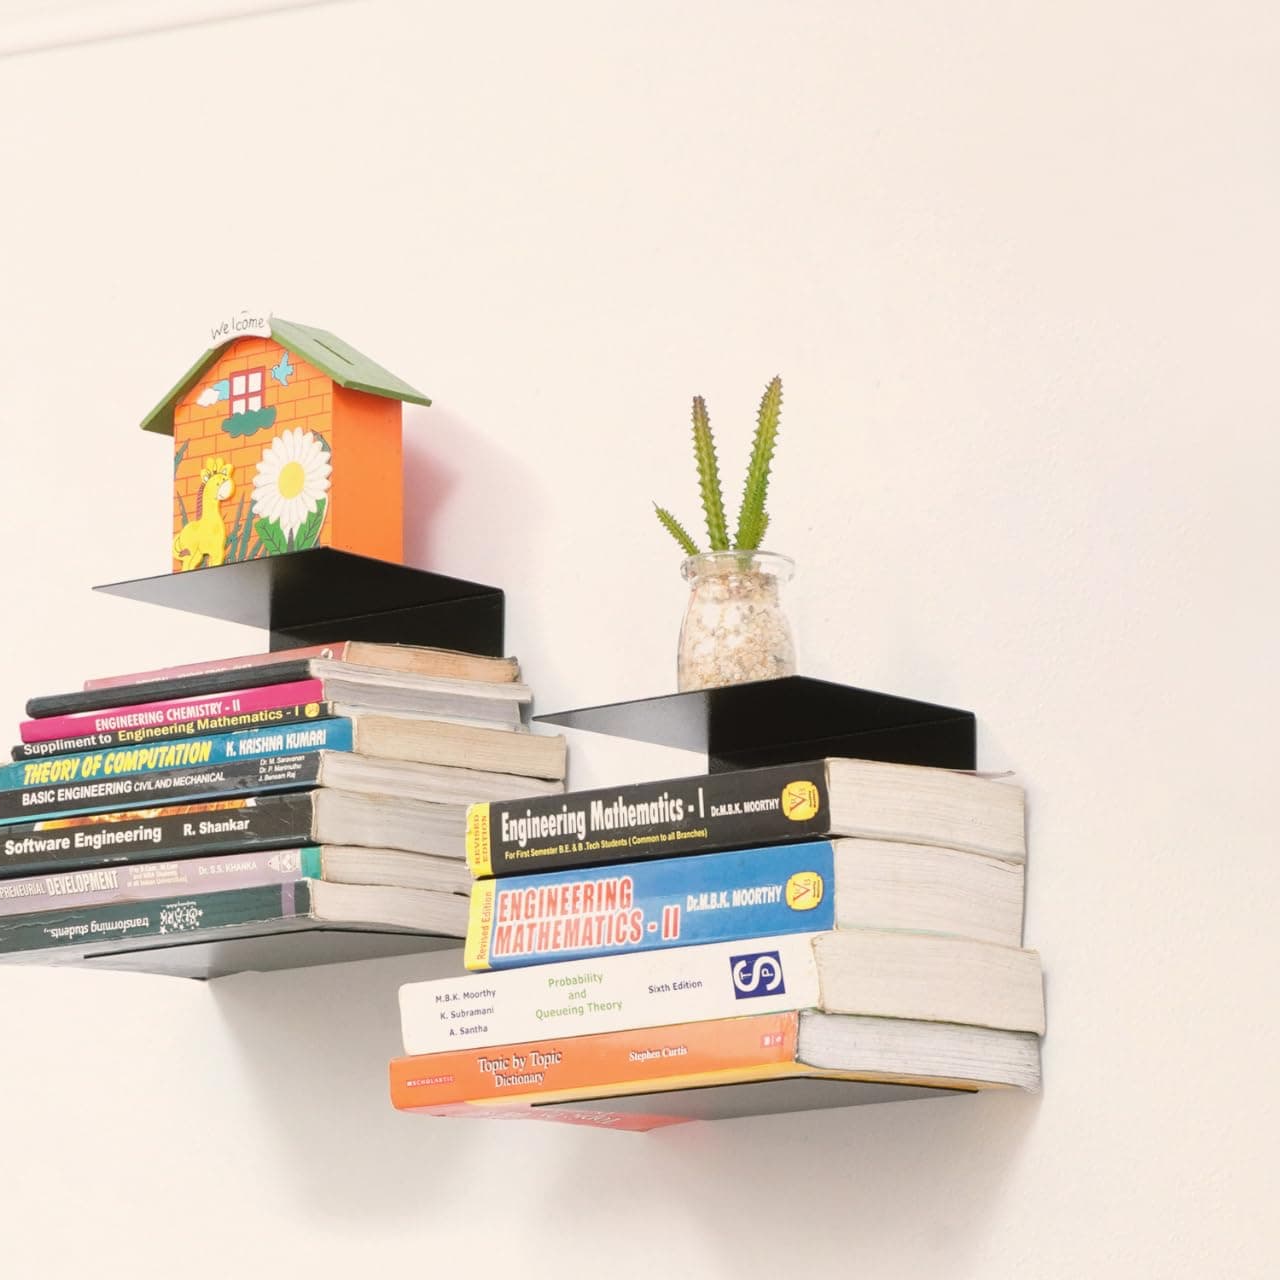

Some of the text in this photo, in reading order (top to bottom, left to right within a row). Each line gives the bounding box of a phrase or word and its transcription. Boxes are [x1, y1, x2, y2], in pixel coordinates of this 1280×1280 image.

[210, 315, 265, 340] Welcome
[95, 710, 164, 731] ENGINEERING
[166, 701, 223, 721] CHEMISTRY
[23, 734, 97, 756] Suppliment
[98, 733, 112, 745] to
[117, 721, 194, 742] Engineering
[197, 709, 283, 731] Mathematics
[225, 729, 327, 757] K. KRISHNA KUMARI
[23, 740, 213, 785] THEORY OF COMPUTATION
[22, 771, 226, 806] BASIC ENGINEERING CIVIL AND MECHANICAL
[743, 798, 780, 813] MOORTHY
[183, 817, 250, 836] R. Shankar
[501, 804, 586, 847] Engineering
[590, 792, 684, 831] Mathematics
[4, 826, 162, 855] Software Engineering
[504, 851, 516, 860] For
[516, 849, 530, 859] First
[530, 846, 558, 857] Semester
[558, 844, 571, 853] B.E.
[601, 838, 628, 848] Students
[660, 833, 667, 841] to
[667, 832, 676, 841] all
[45, 870, 120, 896] DEVELOPMENT
[498, 877, 632, 923] ENGINEERING
[686, 885, 782, 912] Dr.M.B.K. MOORTHY
[90, 916, 150, 934] transforming
[477, 891, 493, 960] Revised Edition
[493, 909, 643, 955] MATHEMATICS
[548, 973, 605, 988] Probability
[648, 979, 703, 994] Sixth Edition
[435, 989, 497, 1004] M.B.K. Moorthy
[568, 989, 587, 1000] and
[439, 1007, 495, 1020] K. Subramani
[535, 999, 624, 1021] Queueing Theory
[449, 1025, 489, 1037] A. Santha
[477, 1049, 563, 1075] Topic by Topic
[628, 1045, 688, 1063] Stephen Curtis
[411, 1075, 454, 1087] SCHOLASTIC
[494, 1070, 545, 1088] Dictionary
